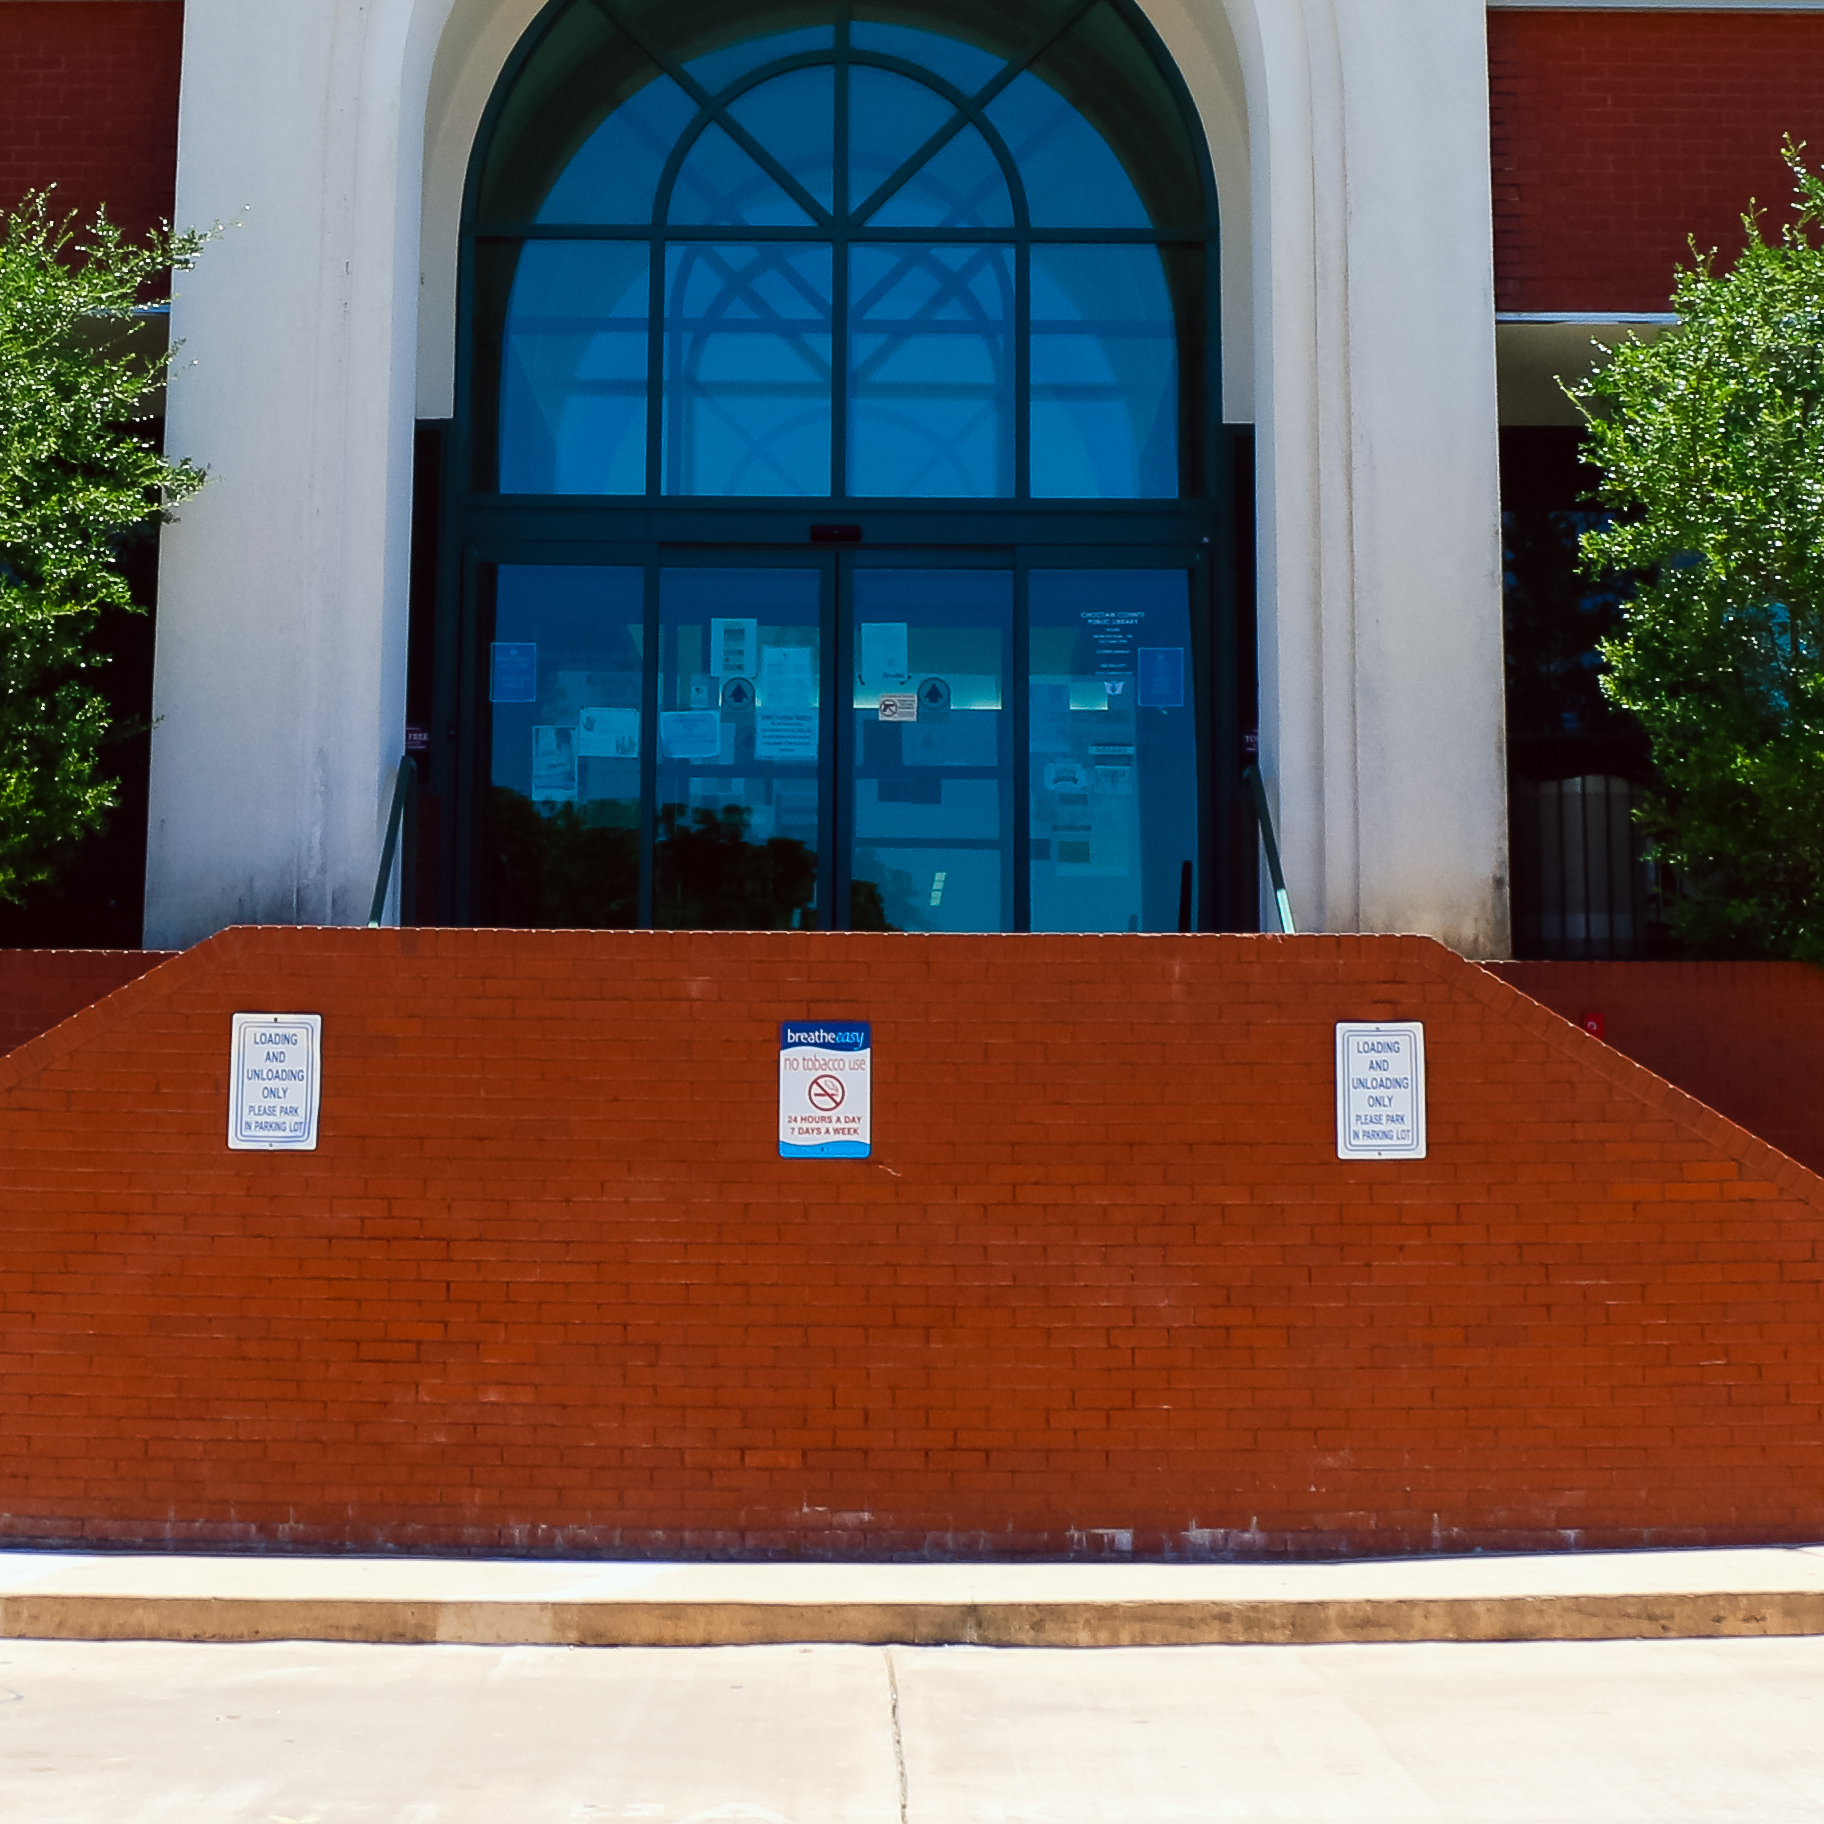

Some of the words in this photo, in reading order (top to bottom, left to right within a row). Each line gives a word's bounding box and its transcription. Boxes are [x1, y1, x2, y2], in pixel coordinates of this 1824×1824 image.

[253, 1033, 298, 1046] LOADING
[1357, 1041, 1400, 1054] LOADING
[264, 1051, 286, 1063] AND
[784, 1057, 799, 1071] no
[802, 1054, 846, 1071] tobacco
[849, 1057, 866, 1071] use
[1368, 1059, 1389, 1072] AND
[246, 1069, 305, 1082] UNLOADING
[1351, 1077, 1409, 1090] UNLOADING
[261, 1087, 288, 1099] ONLY
[1367, 1095, 1393, 1108] ONLY
[248, 1105, 277, 1116] PLEASE
[279, 1106, 299, 1116] PARK
[787, 1115, 797, 1124] 24
[800, 1115, 832, 1124] HOURS
[835, 1115, 842, 1124] A
[844, 1115, 863, 1124] DAY
[1356, 1114, 1383, 1125] PLEASE
[1386, 1114, 1405, 1124] PARK
[244, 1121, 252, 1132] IN
[254, 1121, 287, 1132] PARKING
[289, 1121, 304, 1133] LOT
[790, 1127, 795, 1135] 7
[798, 1127, 822, 1135] DAYS
[824, 1127, 831, 1135] A
[833, 1127, 859, 1135] WEEK
[1352, 1129, 1360, 1140] IN
[1362, 1129, 1394, 1140] PARKING
[1396, 1129, 1411, 1140] LOT
